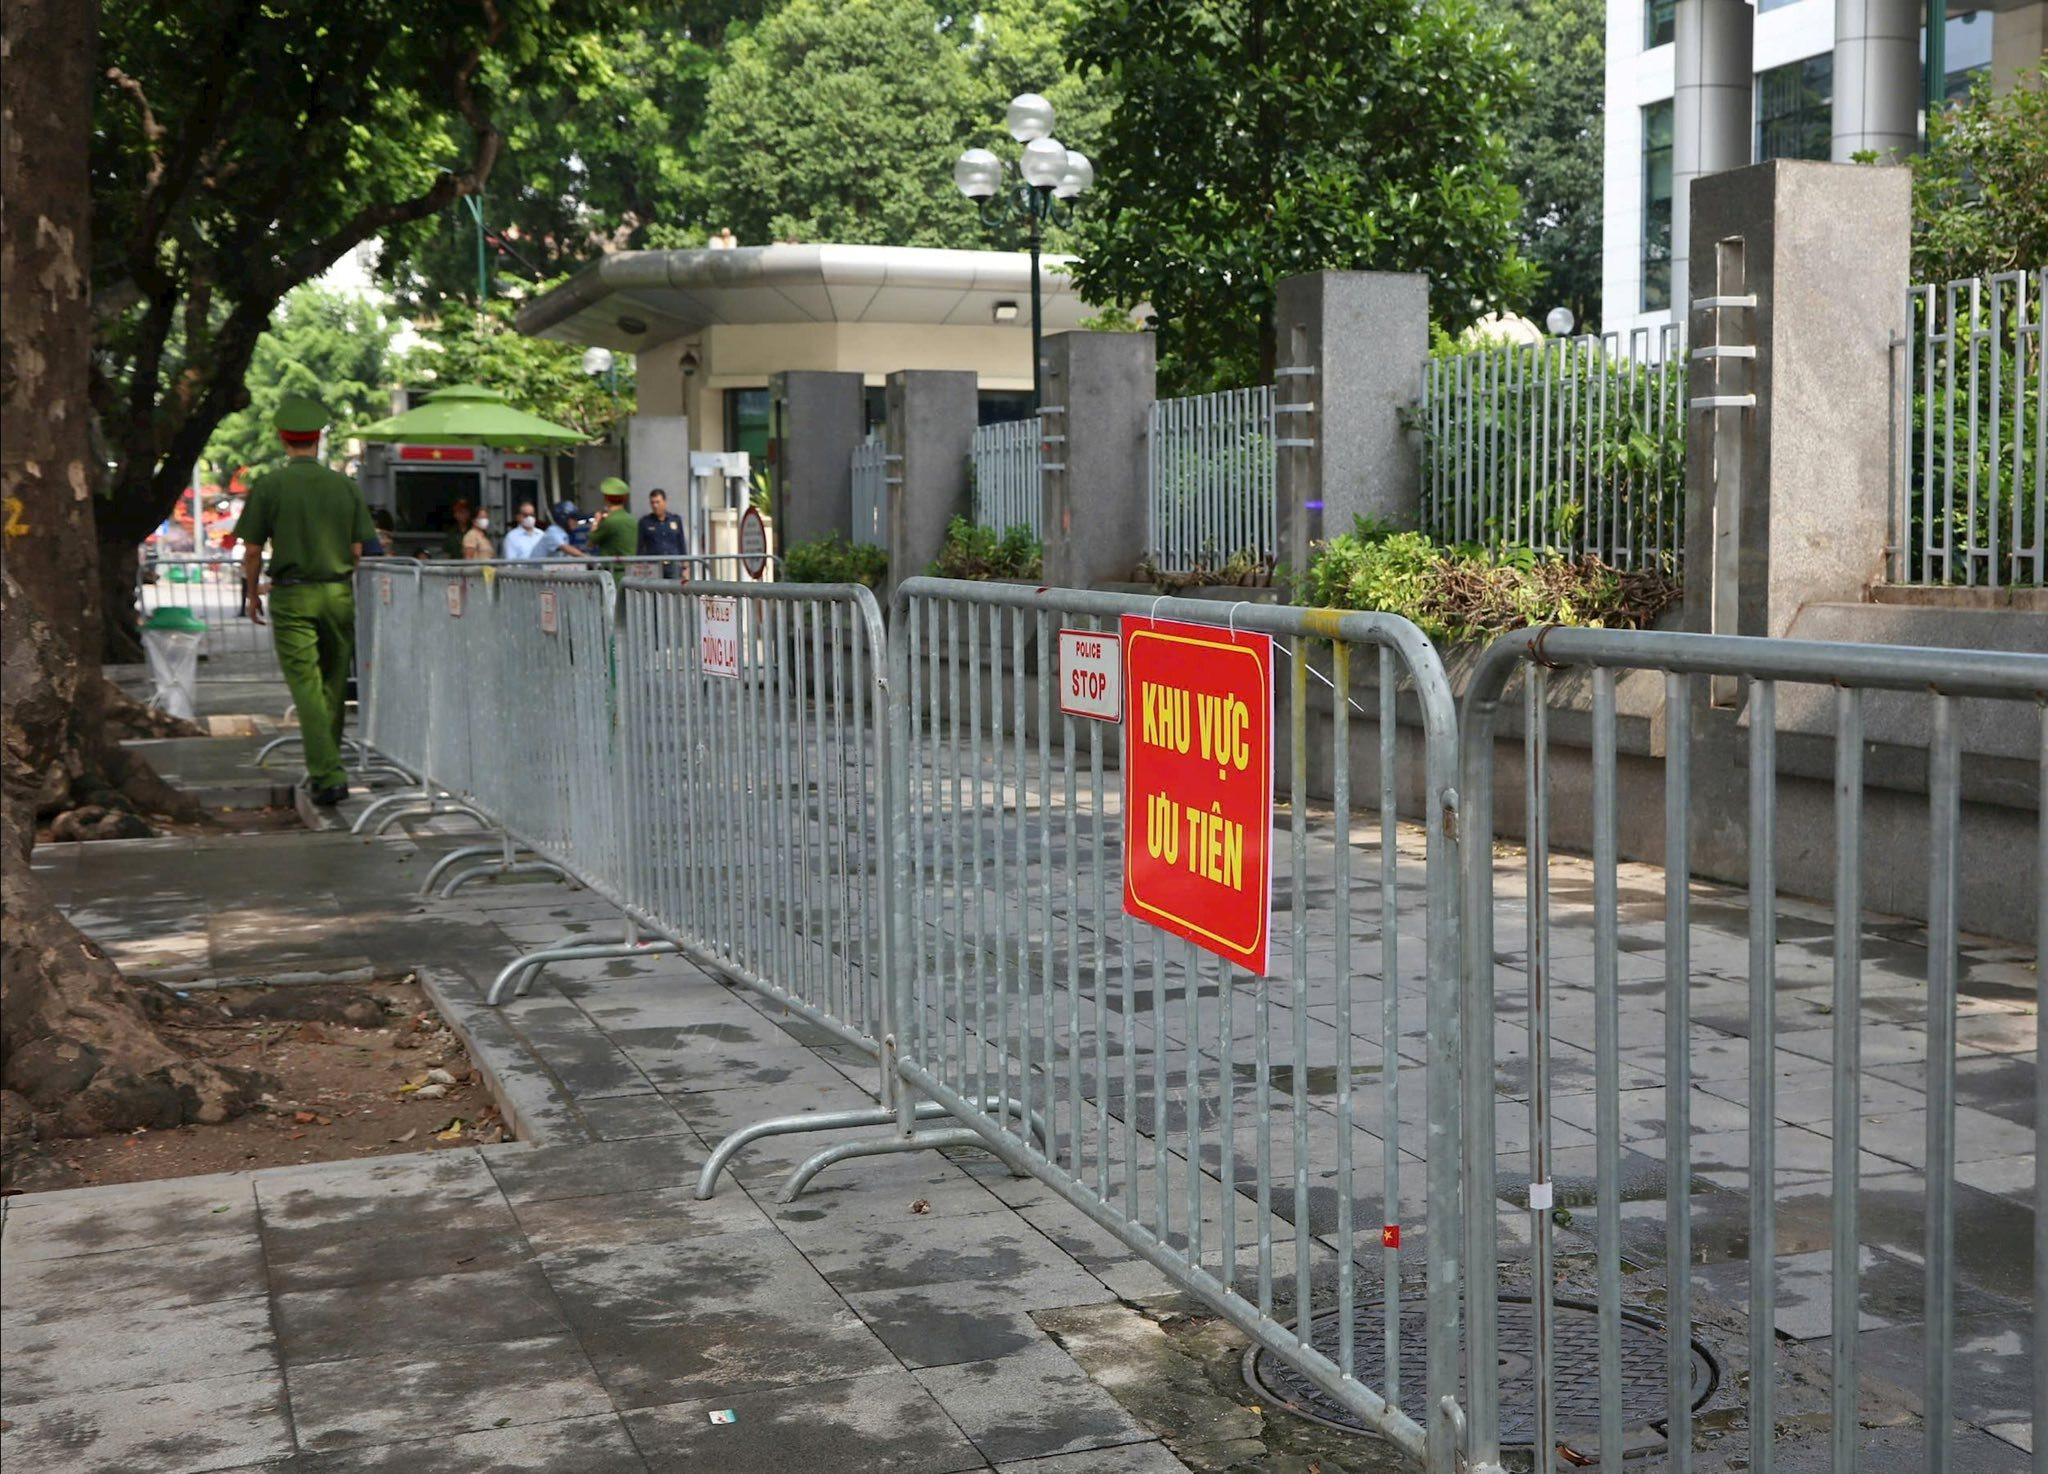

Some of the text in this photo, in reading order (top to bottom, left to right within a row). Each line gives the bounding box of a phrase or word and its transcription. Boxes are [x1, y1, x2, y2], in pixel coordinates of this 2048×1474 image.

[1076, 641, 1101, 659] POLICE
[1072, 669, 1106, 701] STOP
[1142, 681, 1249, 781] KHU VỰC
[1147, 791, 1243, 892] ƯU TIÊN
